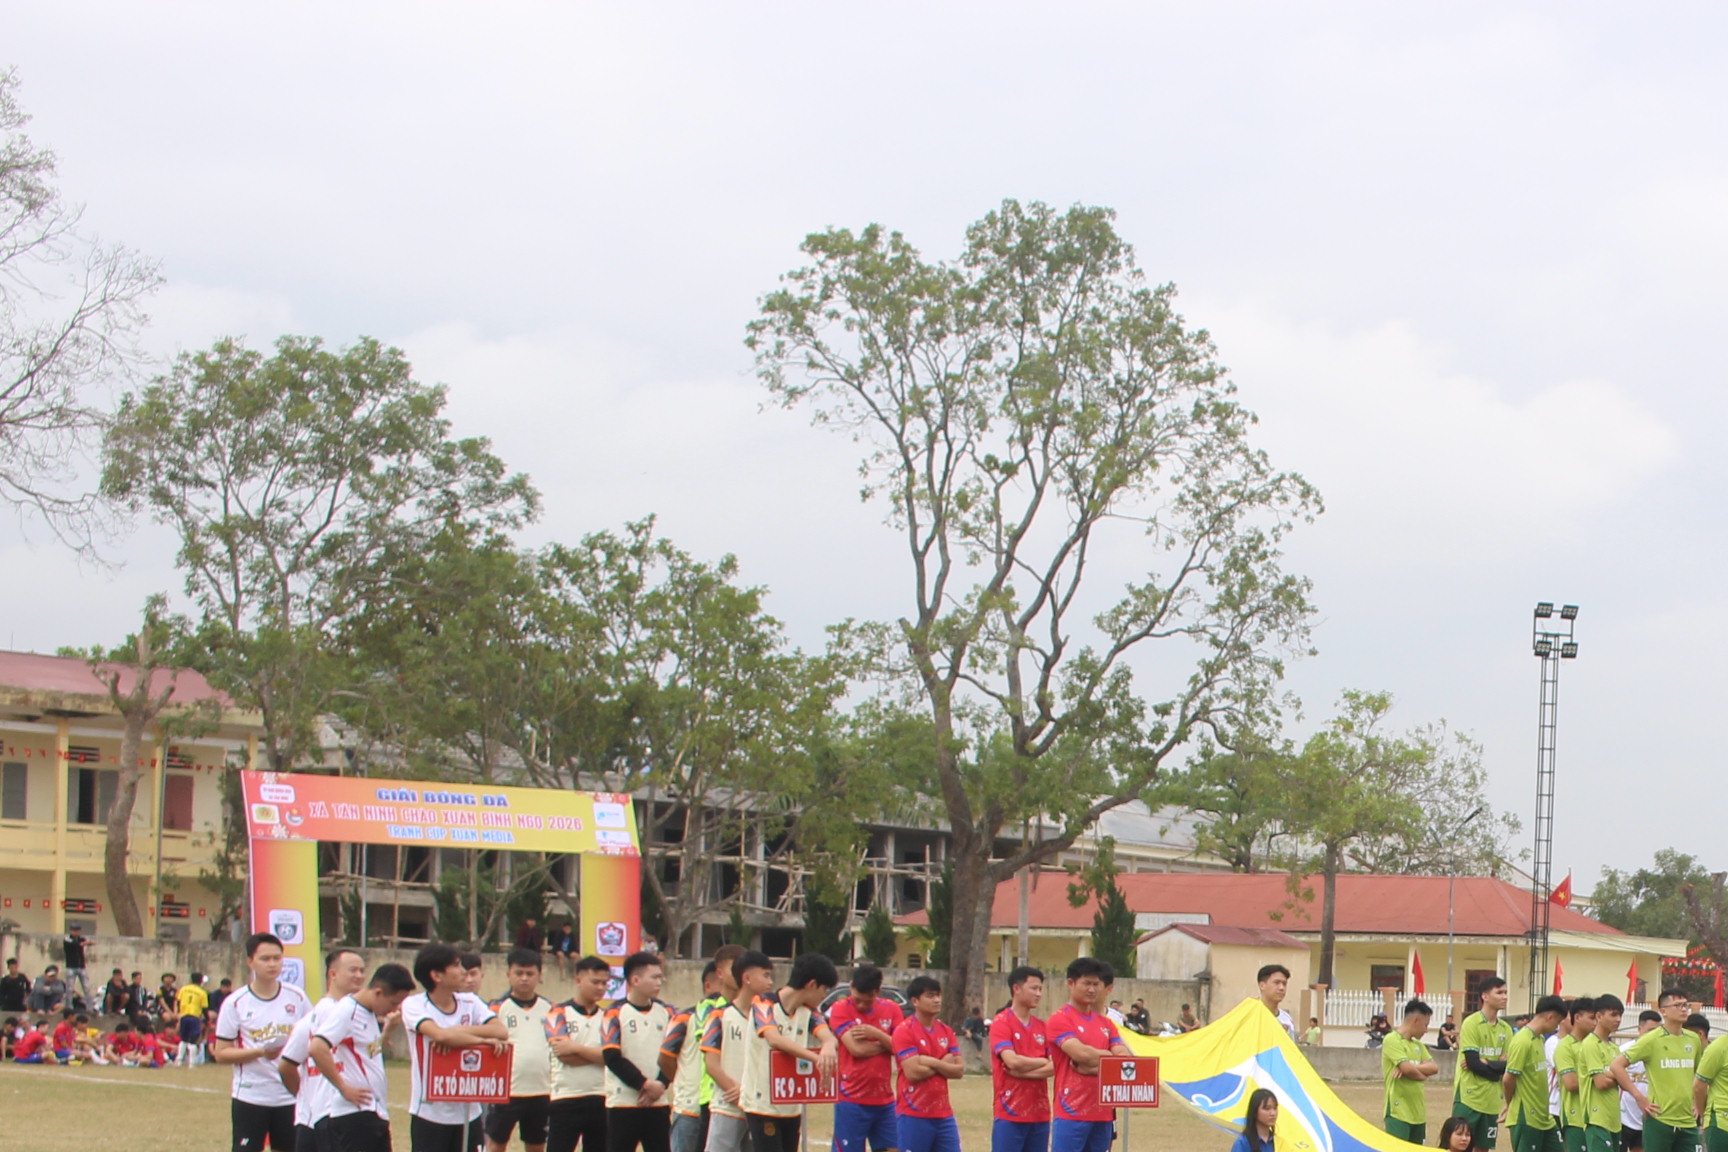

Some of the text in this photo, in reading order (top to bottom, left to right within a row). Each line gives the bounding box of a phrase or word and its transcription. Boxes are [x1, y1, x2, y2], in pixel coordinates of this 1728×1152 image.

[363, 804, 397, 822] NINH
[548, 816, 583, 831] 2026
[482, 829, 515, 843] MEDIA
[507, 1015, 517, 1028] 18
[629, 1019, 637, 1033] 9
[731, 1025, 742, 1040] 14
[433, 1076, 444, 1095] FC
[459, 1073, 477, 1096] DÂN
[498, 1077, 504, 1096] 8
[775, 1077, 786, 1098] FC
[788, 1077, 795, 1097] 9
[805, 1077, 817, 1097] 10
[1102, 1085, 1111, 1102] FC
